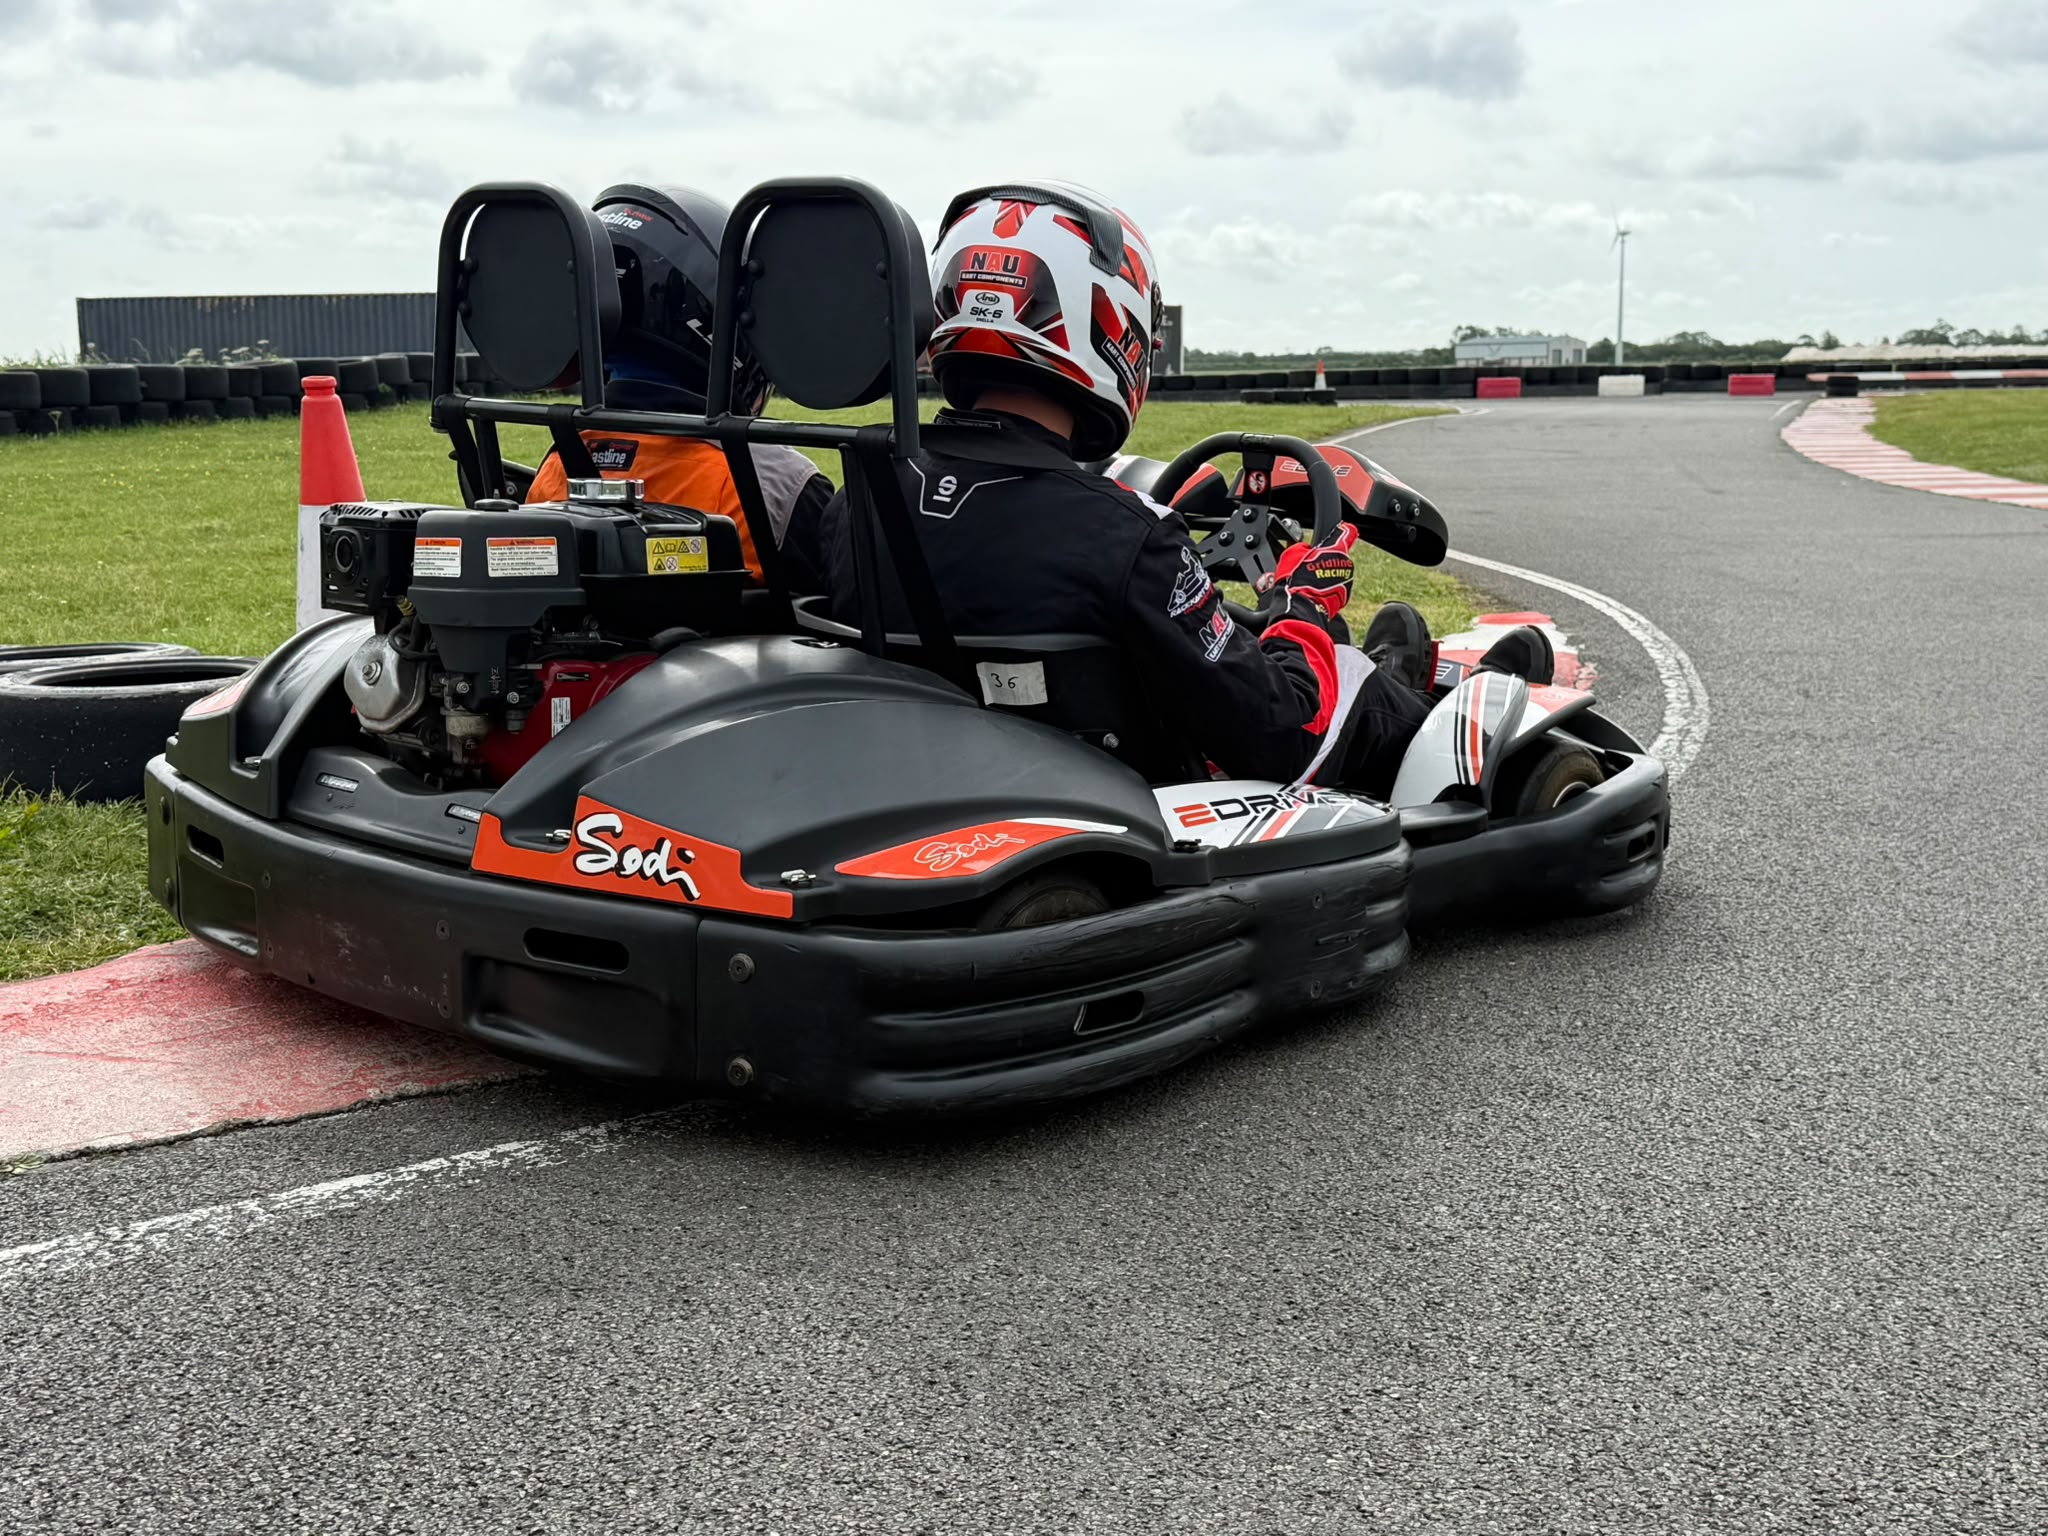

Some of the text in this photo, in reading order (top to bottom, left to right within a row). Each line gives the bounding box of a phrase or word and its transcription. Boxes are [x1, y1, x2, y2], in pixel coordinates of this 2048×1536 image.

[970, 251, 1020, 275] NAU
[970, 306, 1003, 318] SK-6
[592, 448, 626, 464] astline
[1306, 558, 1353, 571] Gridline
[1315, 568, 1352, 579] Racing
[573, 812, 701, 902] Sodi
[914, 834, 1025, 872] Sodi
